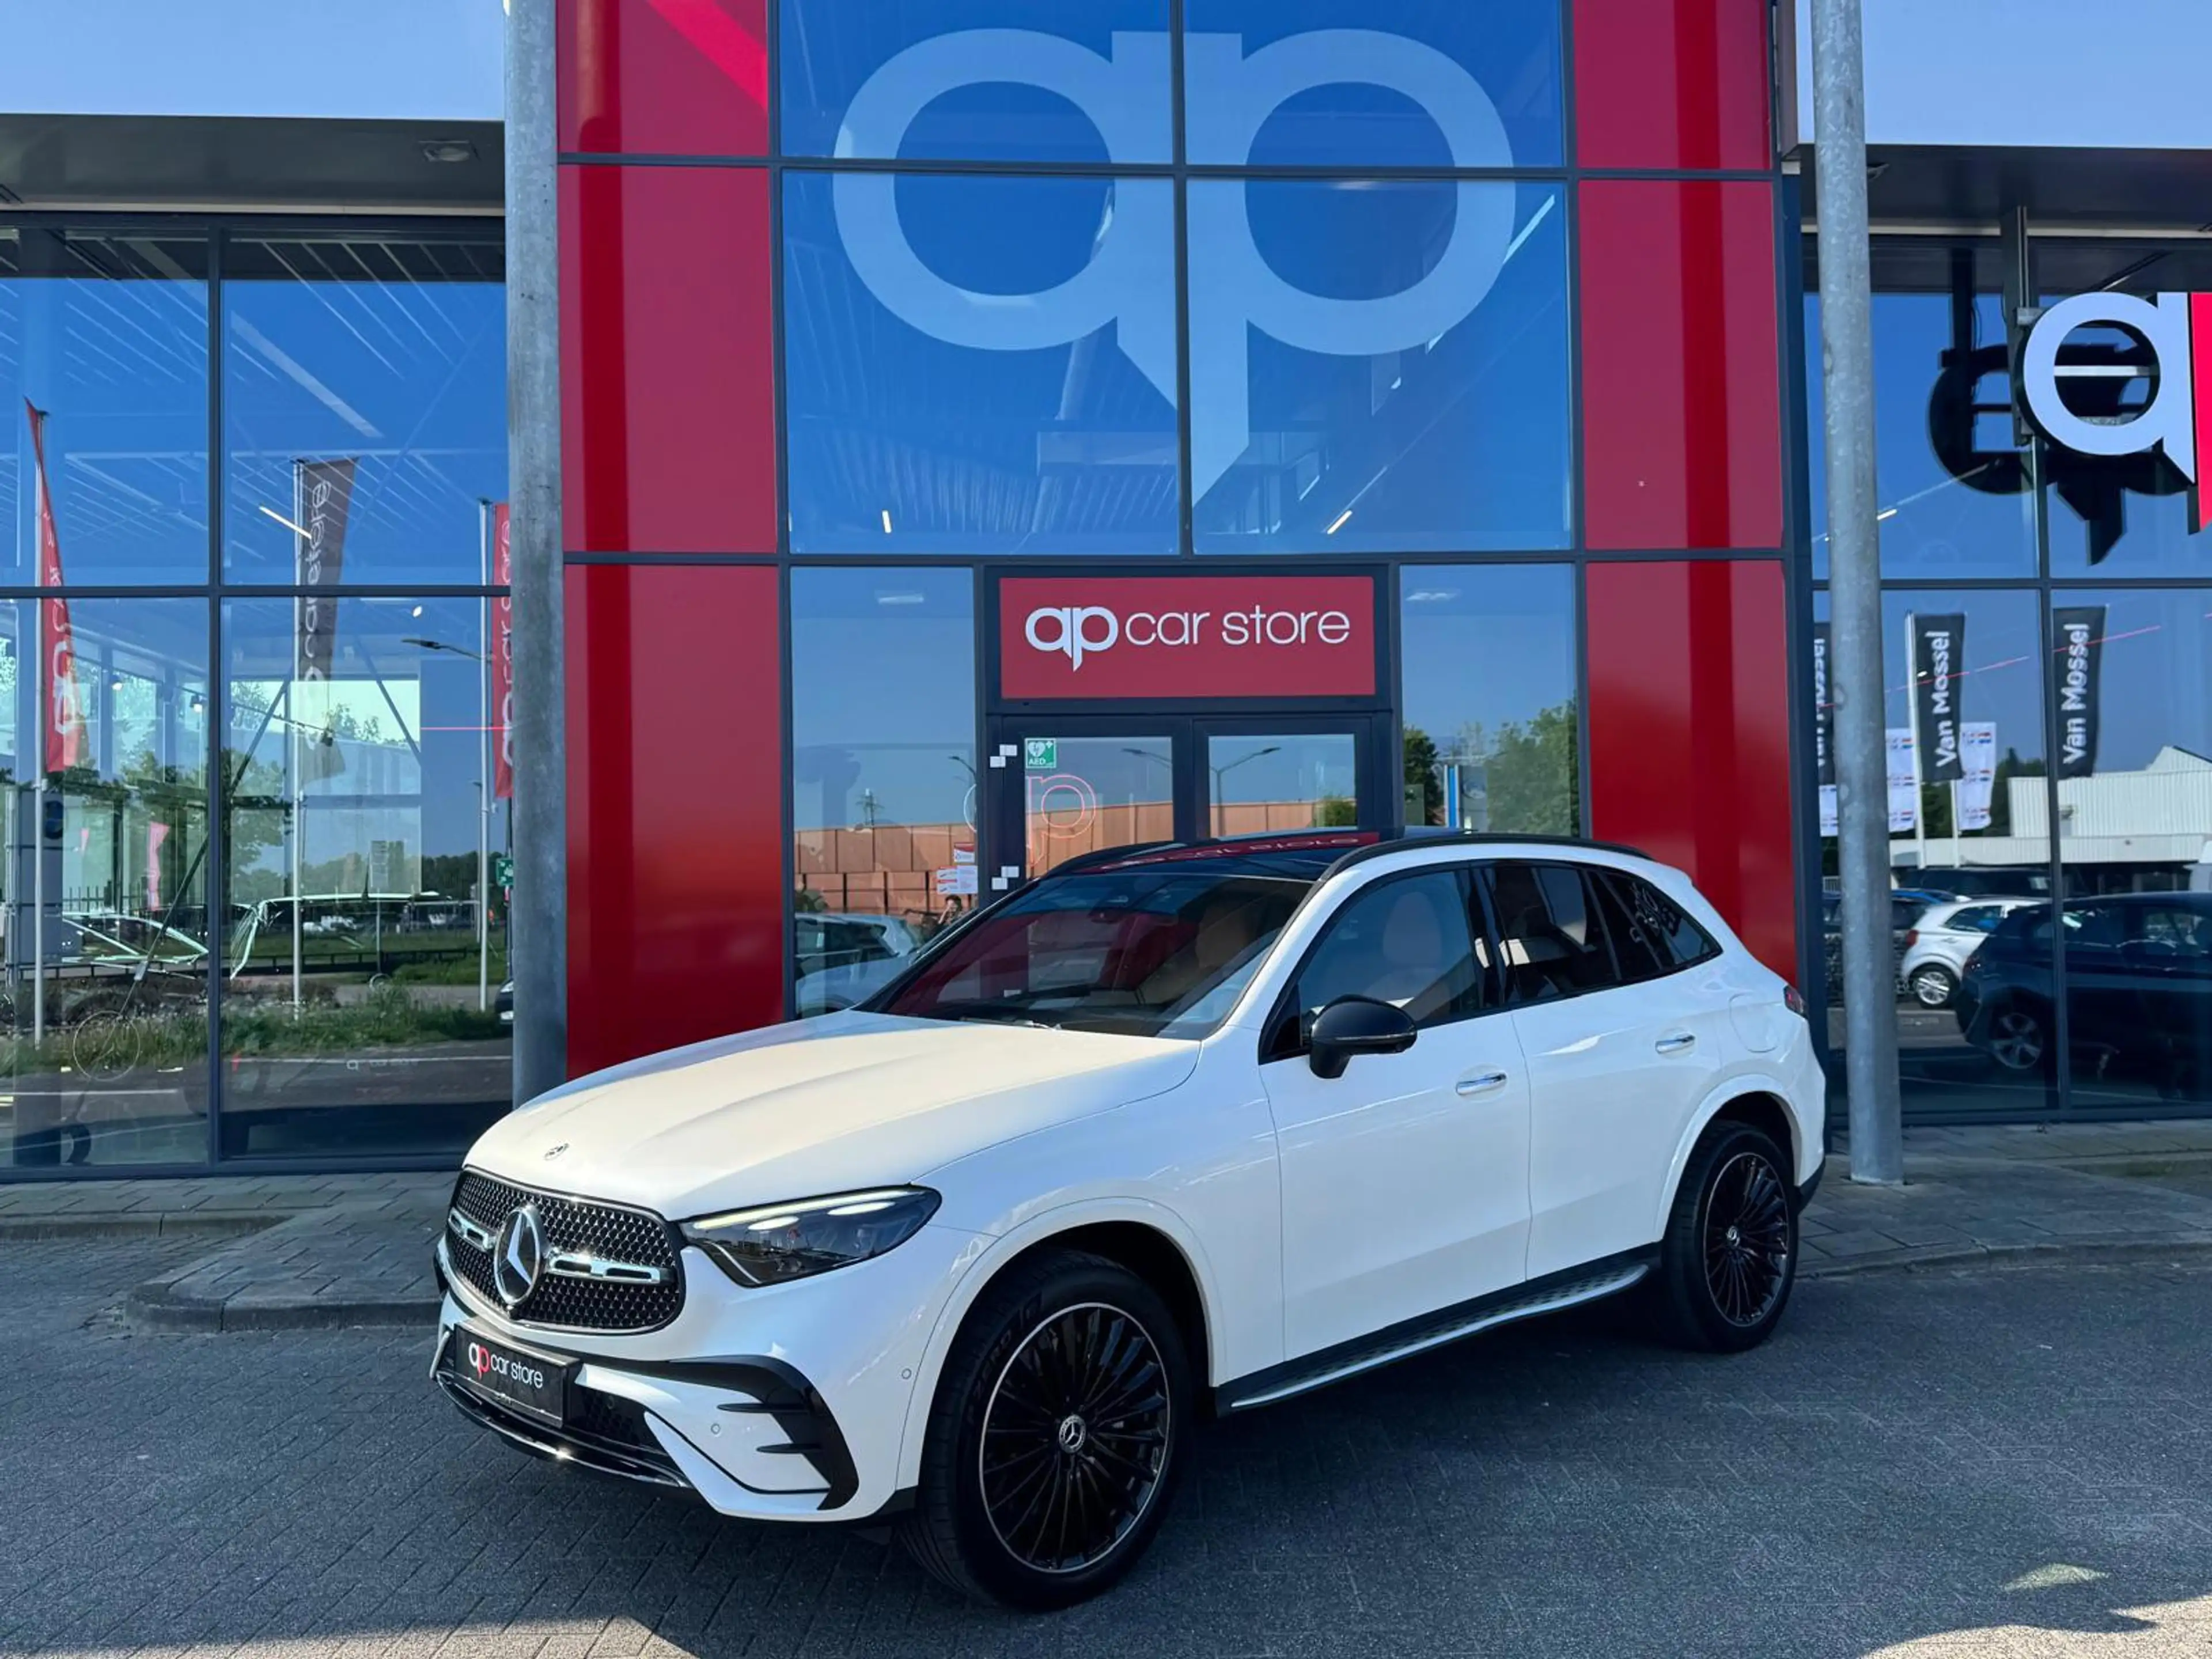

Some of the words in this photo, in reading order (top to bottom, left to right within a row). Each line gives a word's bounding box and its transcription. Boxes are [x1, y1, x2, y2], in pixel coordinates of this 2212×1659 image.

[1025, 606, 1119, 672] ap
[1126, 612, 1210, 645] car
[1222, 605, 1350, 645] store
[1925, 631, 1950, 714] Mossel
[2061, 624, 2089, 711] Mossel
[1934, 720, 1957, 767] Van
[2062, 718, 2087, 764] Van
[490, 1354, 510, 1374] car
[511, 1362, 543, 1389] store
